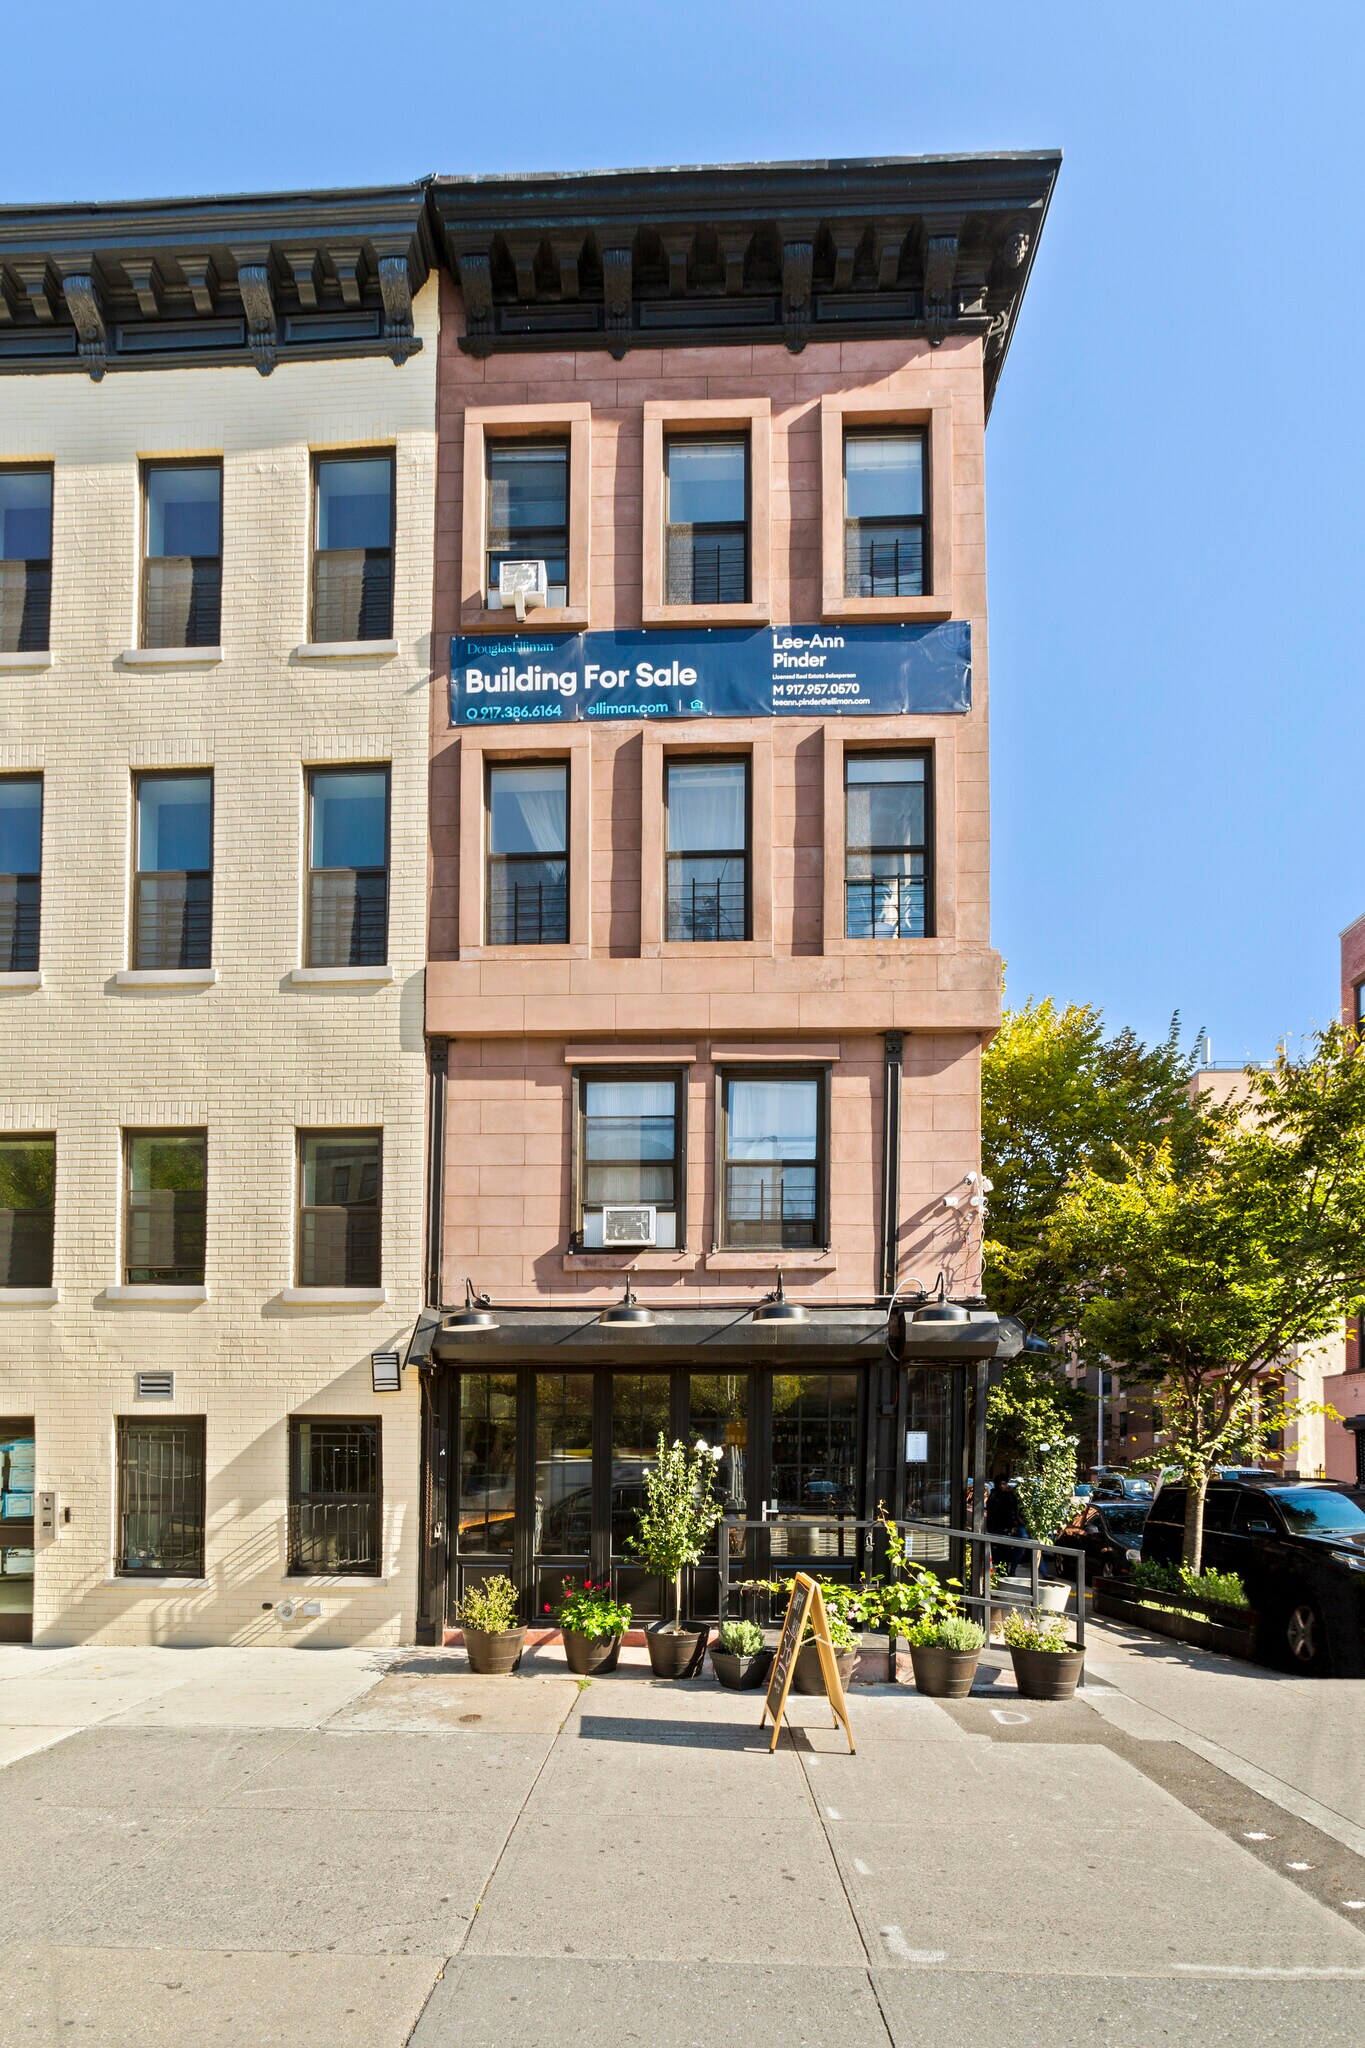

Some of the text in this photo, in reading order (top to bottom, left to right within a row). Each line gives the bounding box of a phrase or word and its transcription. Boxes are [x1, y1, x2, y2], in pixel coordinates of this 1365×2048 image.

[773, 634, 845, 650] Lee-Ann
[773, 652, 828, 668] Pinder
[465, 661, 698, 697] Building For Sale
[825, 672, 857, 680] Salesperson
[772, 682, 860, 696] M 917.957.0570
[772, 697, 871, 707] leeann.pinder@elliman.com
[480, 704, 562, 720] 917.386.6164
[587, 702, 669, 715] elliman.com
